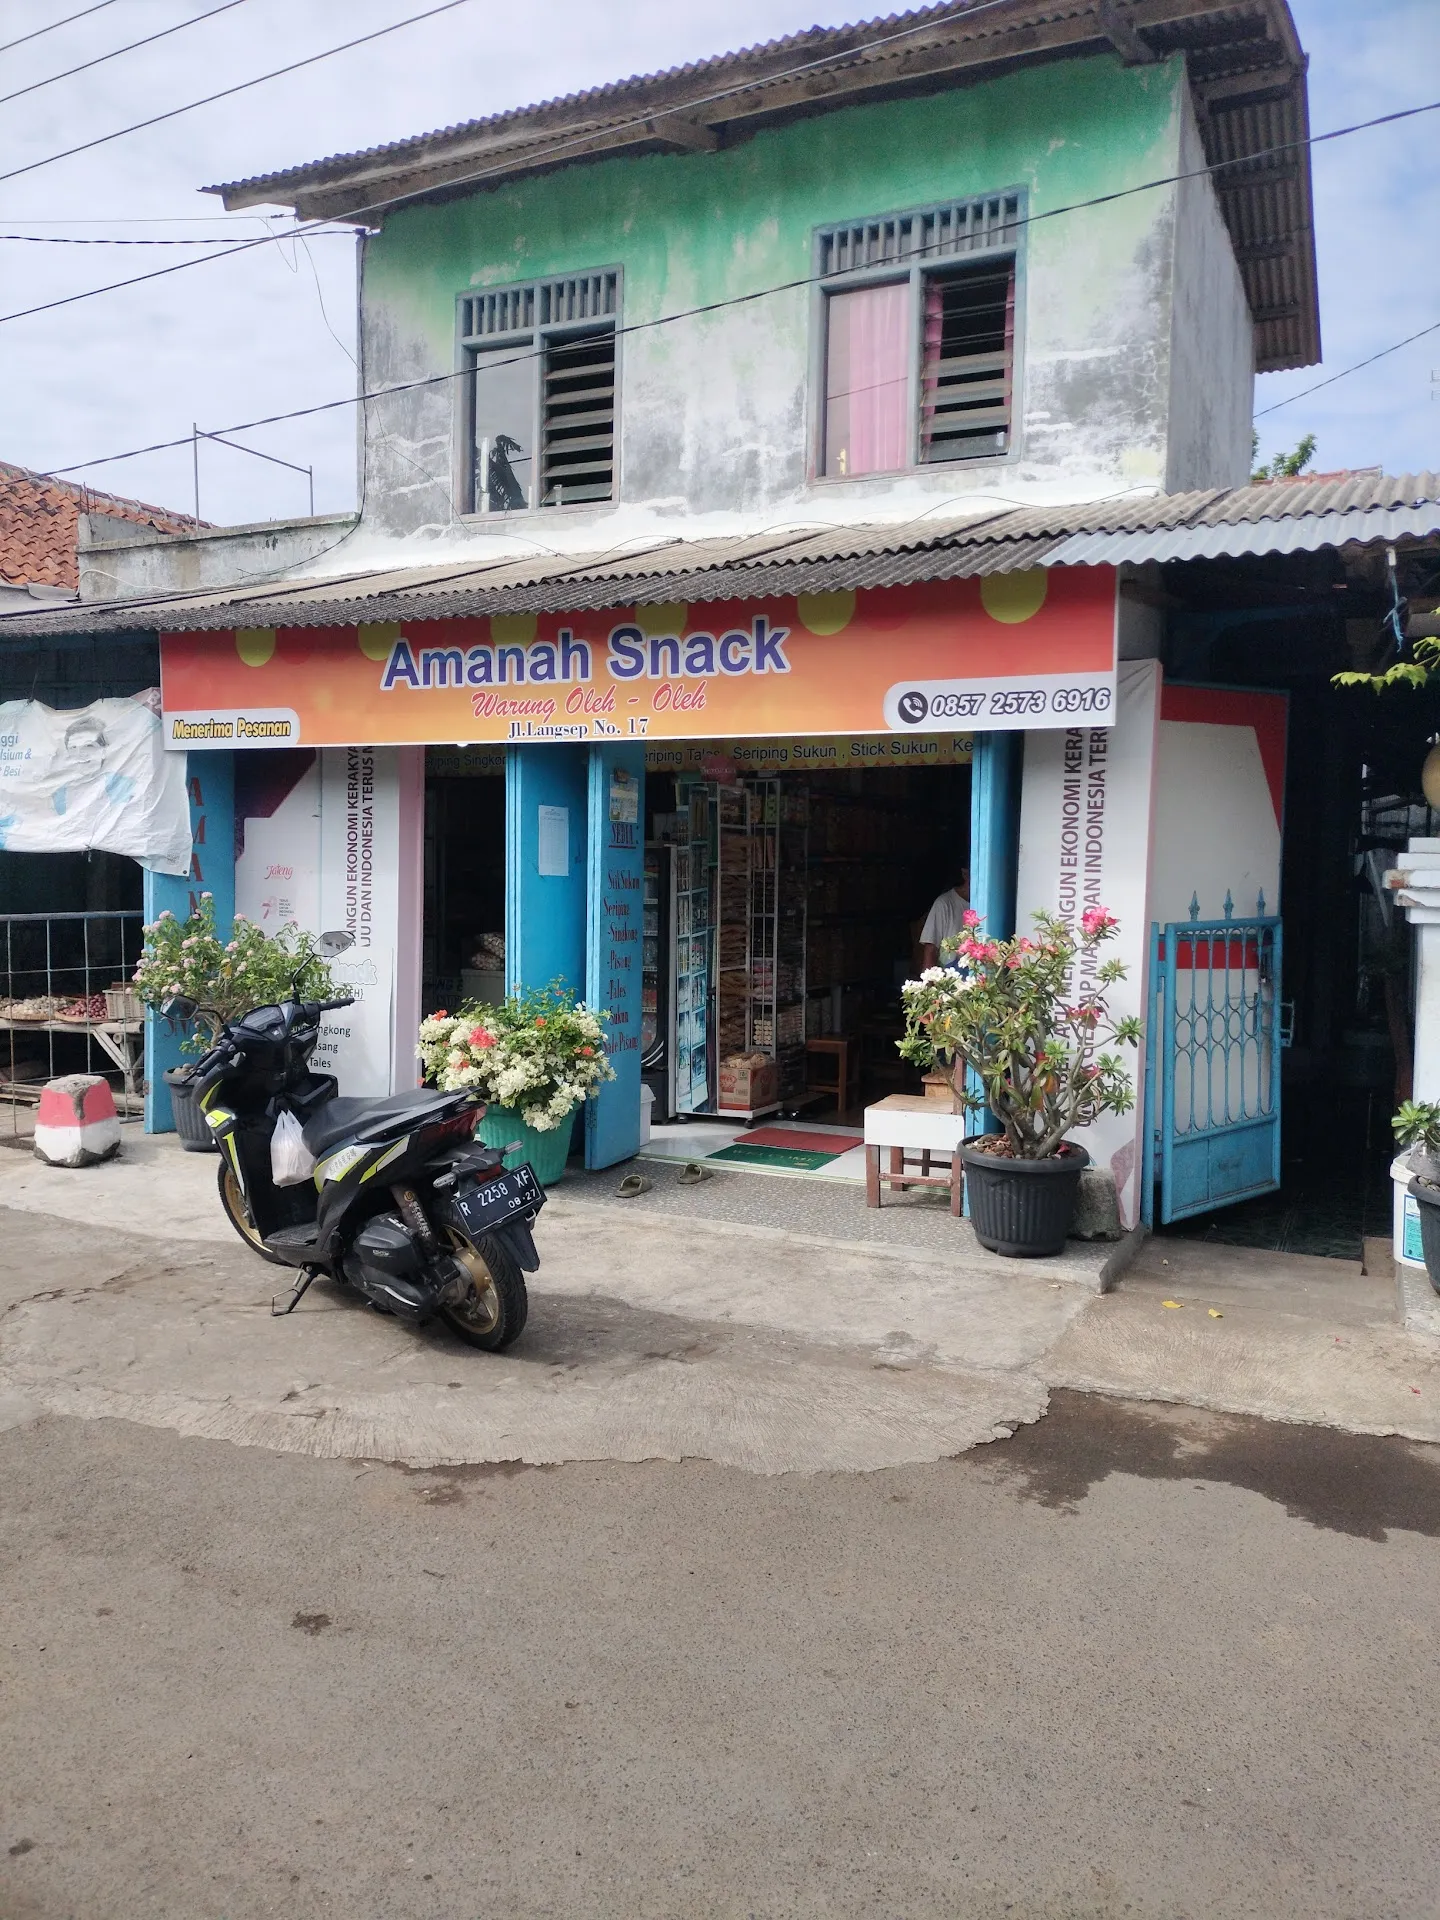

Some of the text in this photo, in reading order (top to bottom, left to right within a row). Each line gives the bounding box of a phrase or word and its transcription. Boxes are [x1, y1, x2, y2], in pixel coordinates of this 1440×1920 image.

[383, 616, 790, 688] Amanah Snack
[472, 691, 557, 723] Warung
[565, 685, 616, 714] Oleh
[653, 680, 706, 711] Oleh
[931, 687, 1111, 717] 0857 2573 6916
[172, 717, 291, 739] Menerima Pesanan
[593, 719, 621, 735] No.
[628, 718, 648, 734] 17
[24, 748, 32, 760] &
[733, 747, 788, 762] Seriping
[792, 744, 837, 759] Sukun
[850, 742, 886, 756] Stick
[891, 740, 937, 755] Sukun
[953, 738, 974, 752] Ke
[3, 765, 21, 776] Besi
[362, 757, 374, 803] TERUS
[1060, 779, 1081, 868] EKONOMI
[1084, 768, 1106, 873] INDONESIA
[347, 811, 358, 882] EKONOMI
[361, 806, 373, 887] INDONESIA
[361, 890, 372, 922] DAN
[317, 1024, 351, 1038] ngkong
[310, 1056, 331, 1068] Tales
[316, 1042, 339, 1054] sang
[459, 1170, 529, 1217] R 2258 XF
